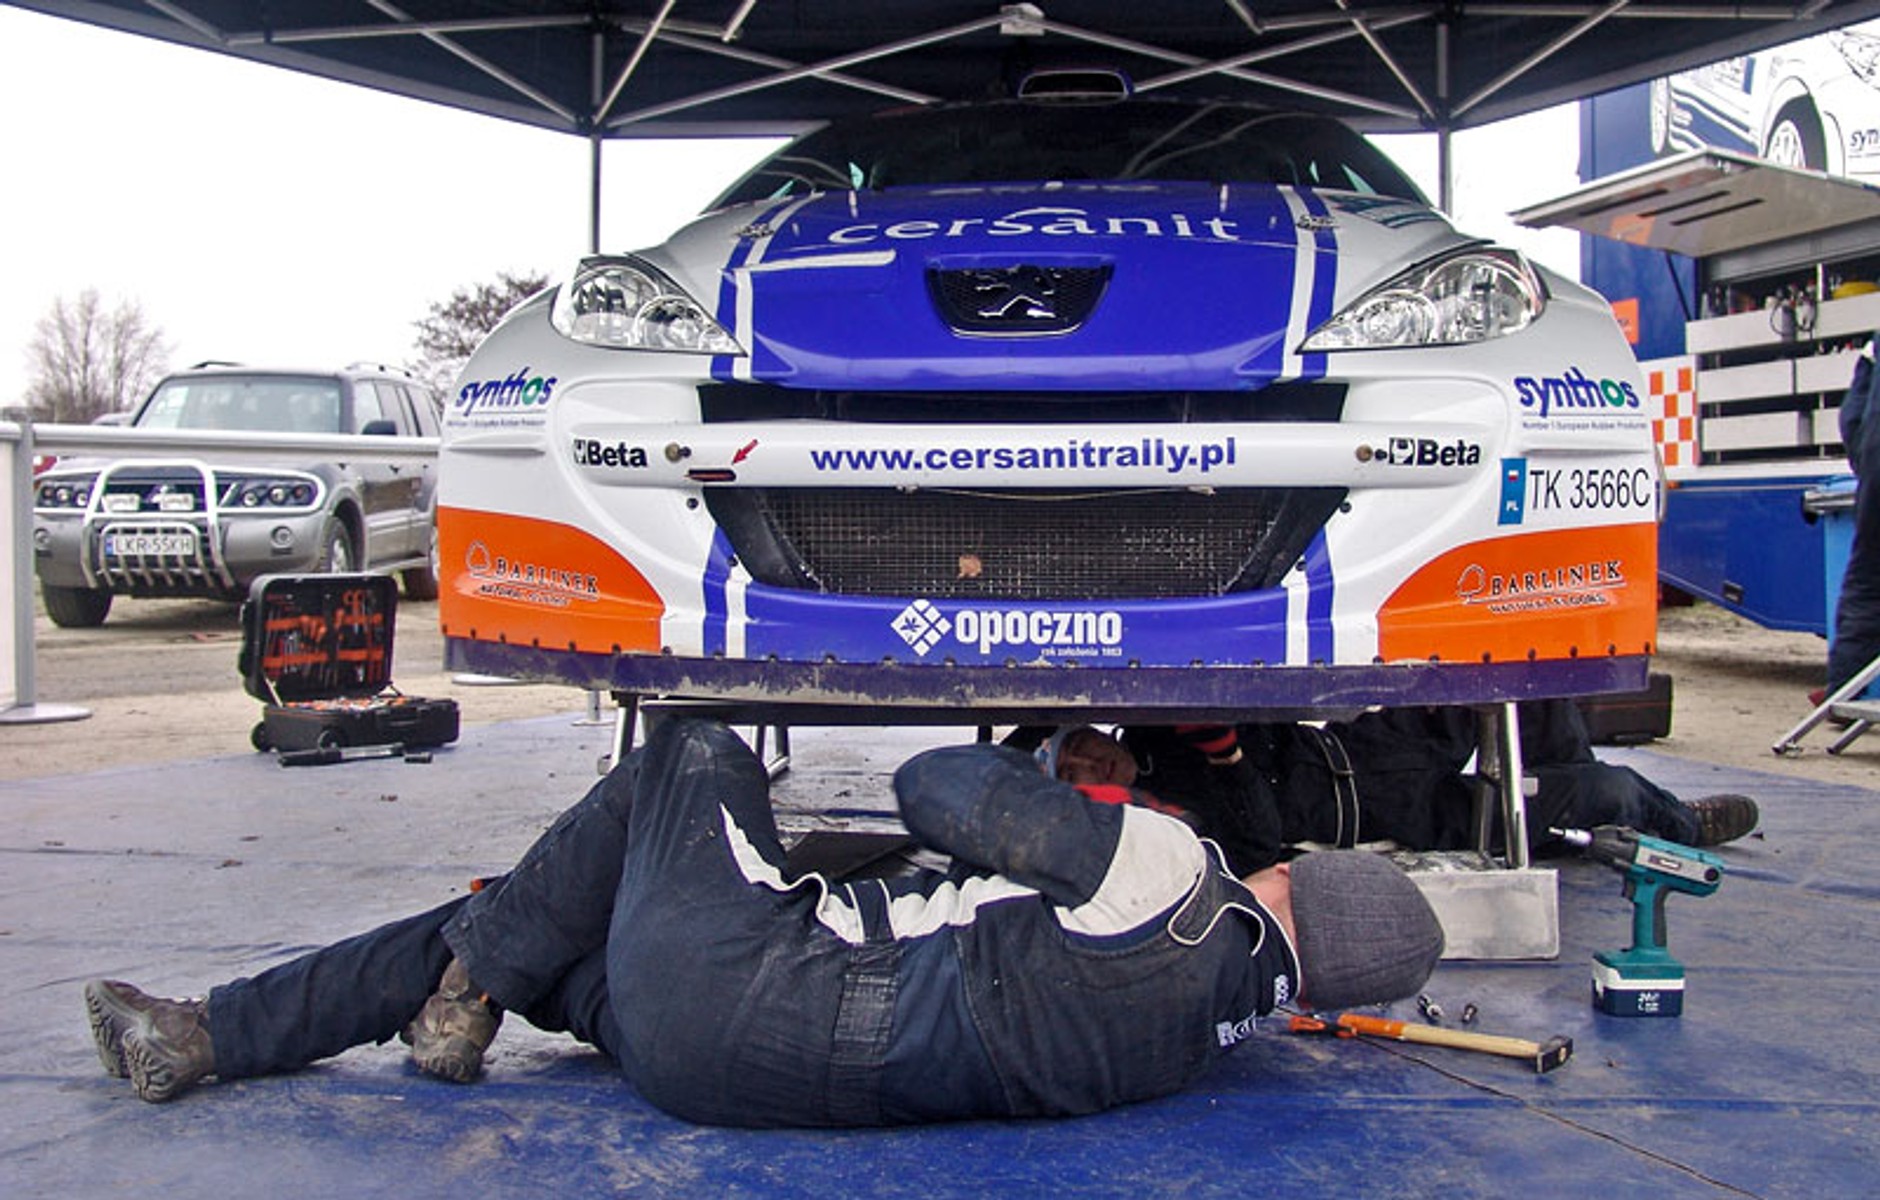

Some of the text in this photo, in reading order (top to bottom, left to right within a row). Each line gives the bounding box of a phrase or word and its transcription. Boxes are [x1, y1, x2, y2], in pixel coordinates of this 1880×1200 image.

[828, 207, 1240, 244] cersanit
[455, 366, 558, 417] synthos
[1513, 366, 1641, 418] synthos
[587, 440, 648, 468] Beta
[811, 436, 1236, 473] www.cersanitrally.pl
[1417, 438, 1481, 466] Beta
[1529, 467, 1651, 510] TK 3566C
[495, 558, 598, 594] BARLINEK
[1491, 560, 1622, 596] BARLINEK
[954, 609, 1123, 655] opoczno
